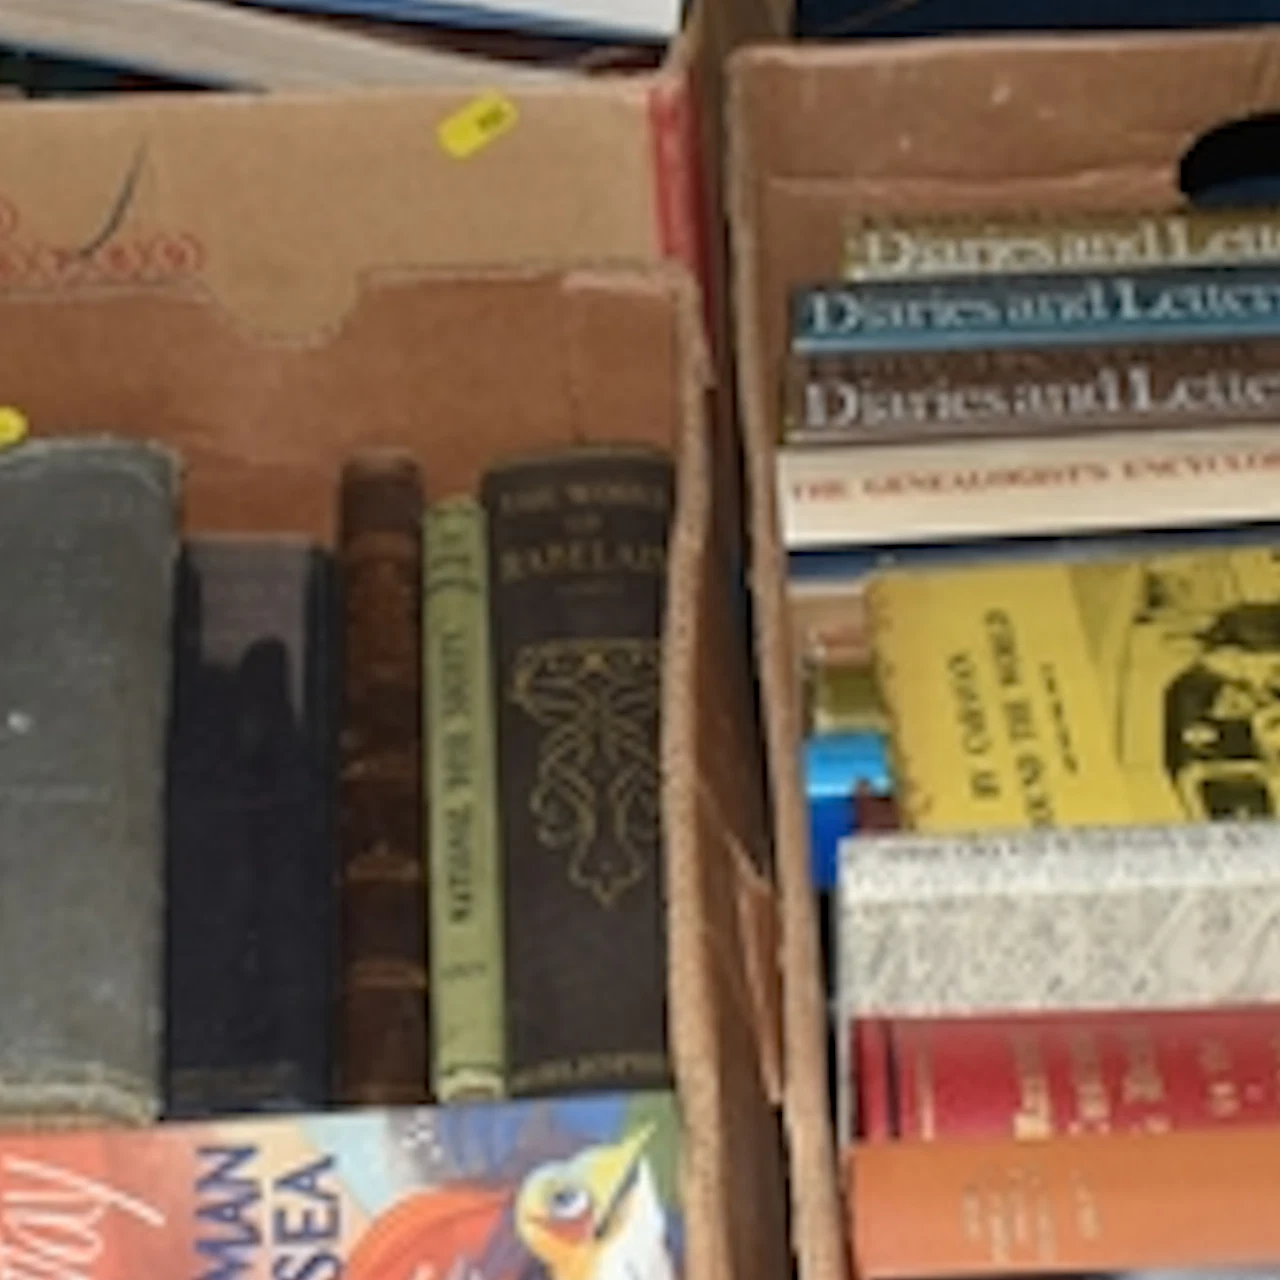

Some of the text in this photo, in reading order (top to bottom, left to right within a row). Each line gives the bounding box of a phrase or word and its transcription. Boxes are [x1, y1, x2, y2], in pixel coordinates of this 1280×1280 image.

[862, 226, 1056, 275] Diaries
[1061, 220, 1157, 266] and
[810, 285, 1002, 334] Diaries
[1005, 278, 1106, 322] and
[805, 376, 1011, 427] Diaries
[1013, 366, 1120, 414] and
[793, 480, 846, 502] THE
